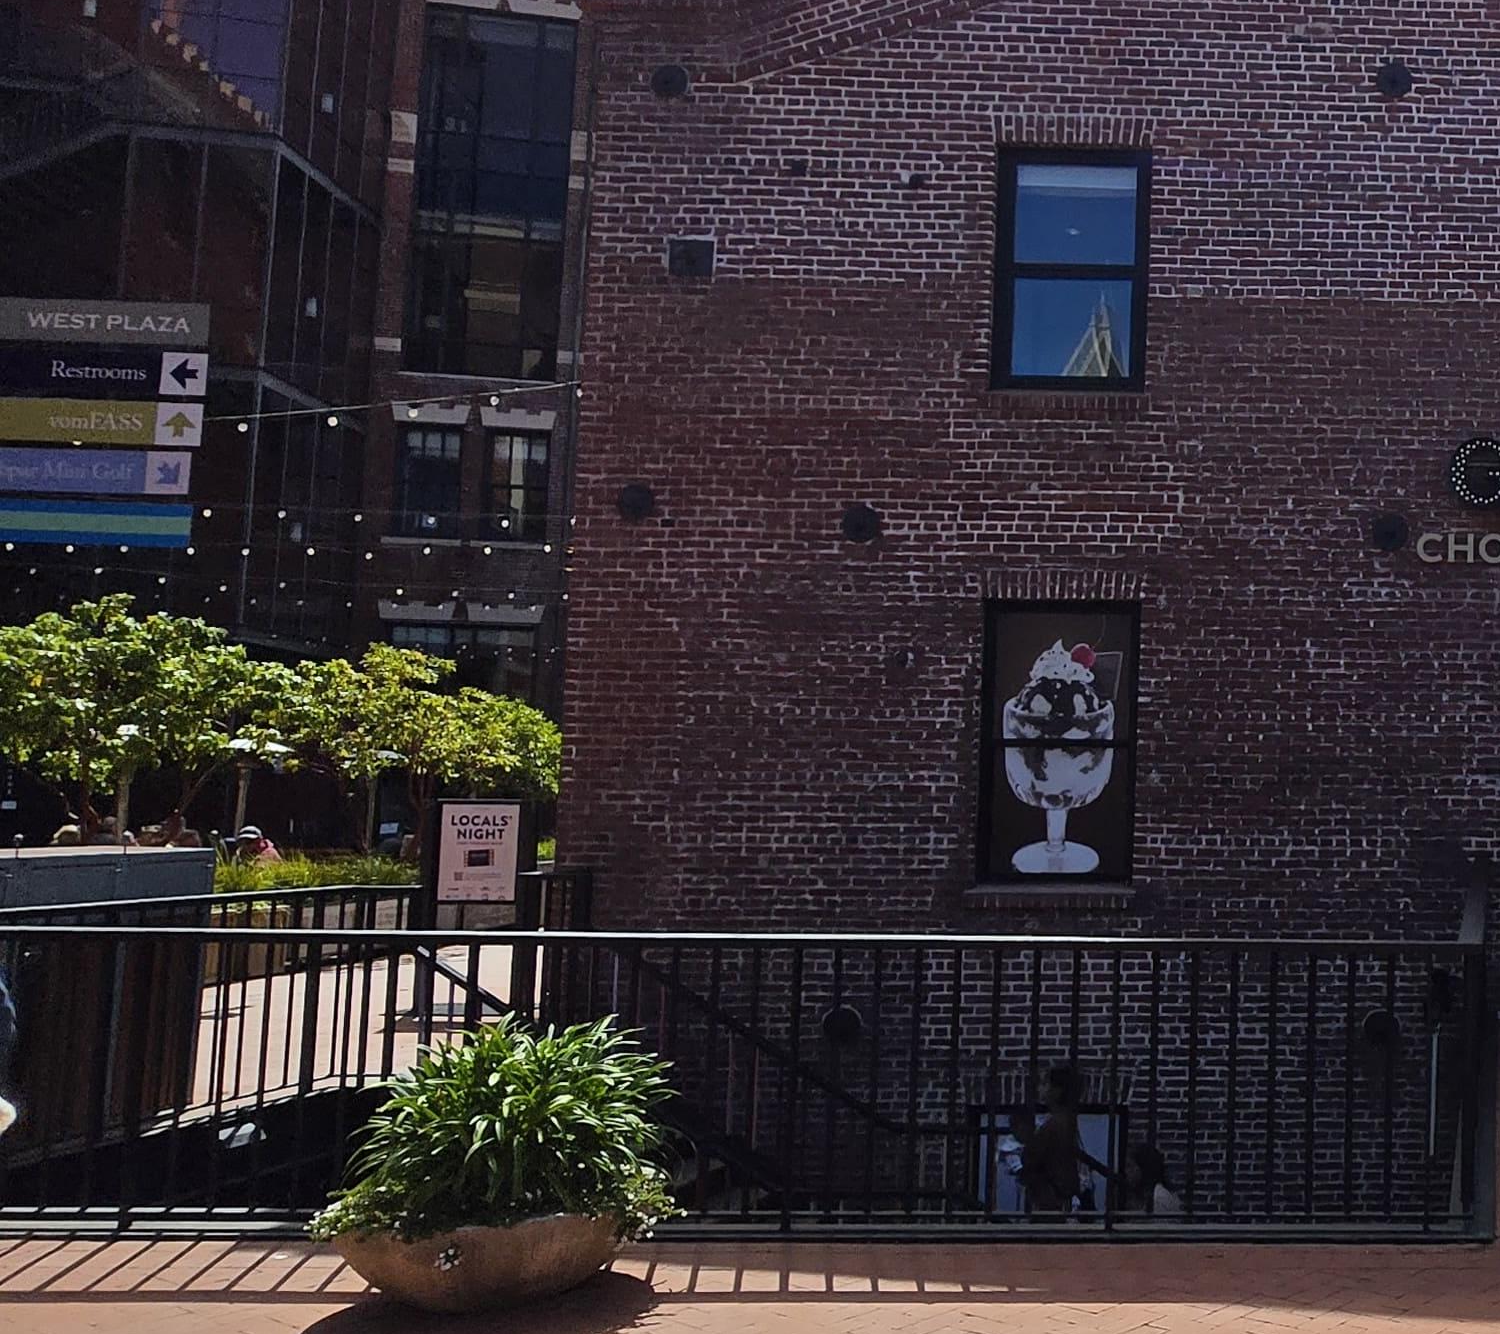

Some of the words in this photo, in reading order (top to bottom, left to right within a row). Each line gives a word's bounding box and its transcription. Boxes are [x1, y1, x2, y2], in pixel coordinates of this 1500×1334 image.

[27, 311, 100, 330] WEST
[106, 314, 191, 334] PLAZA
[51, 358, 147, 381] Restrooms
[49, 410, 144, 431] vomFASS
[93, 463, 135, 480] Golf
[457, 828, 505, 840] NIGHT
